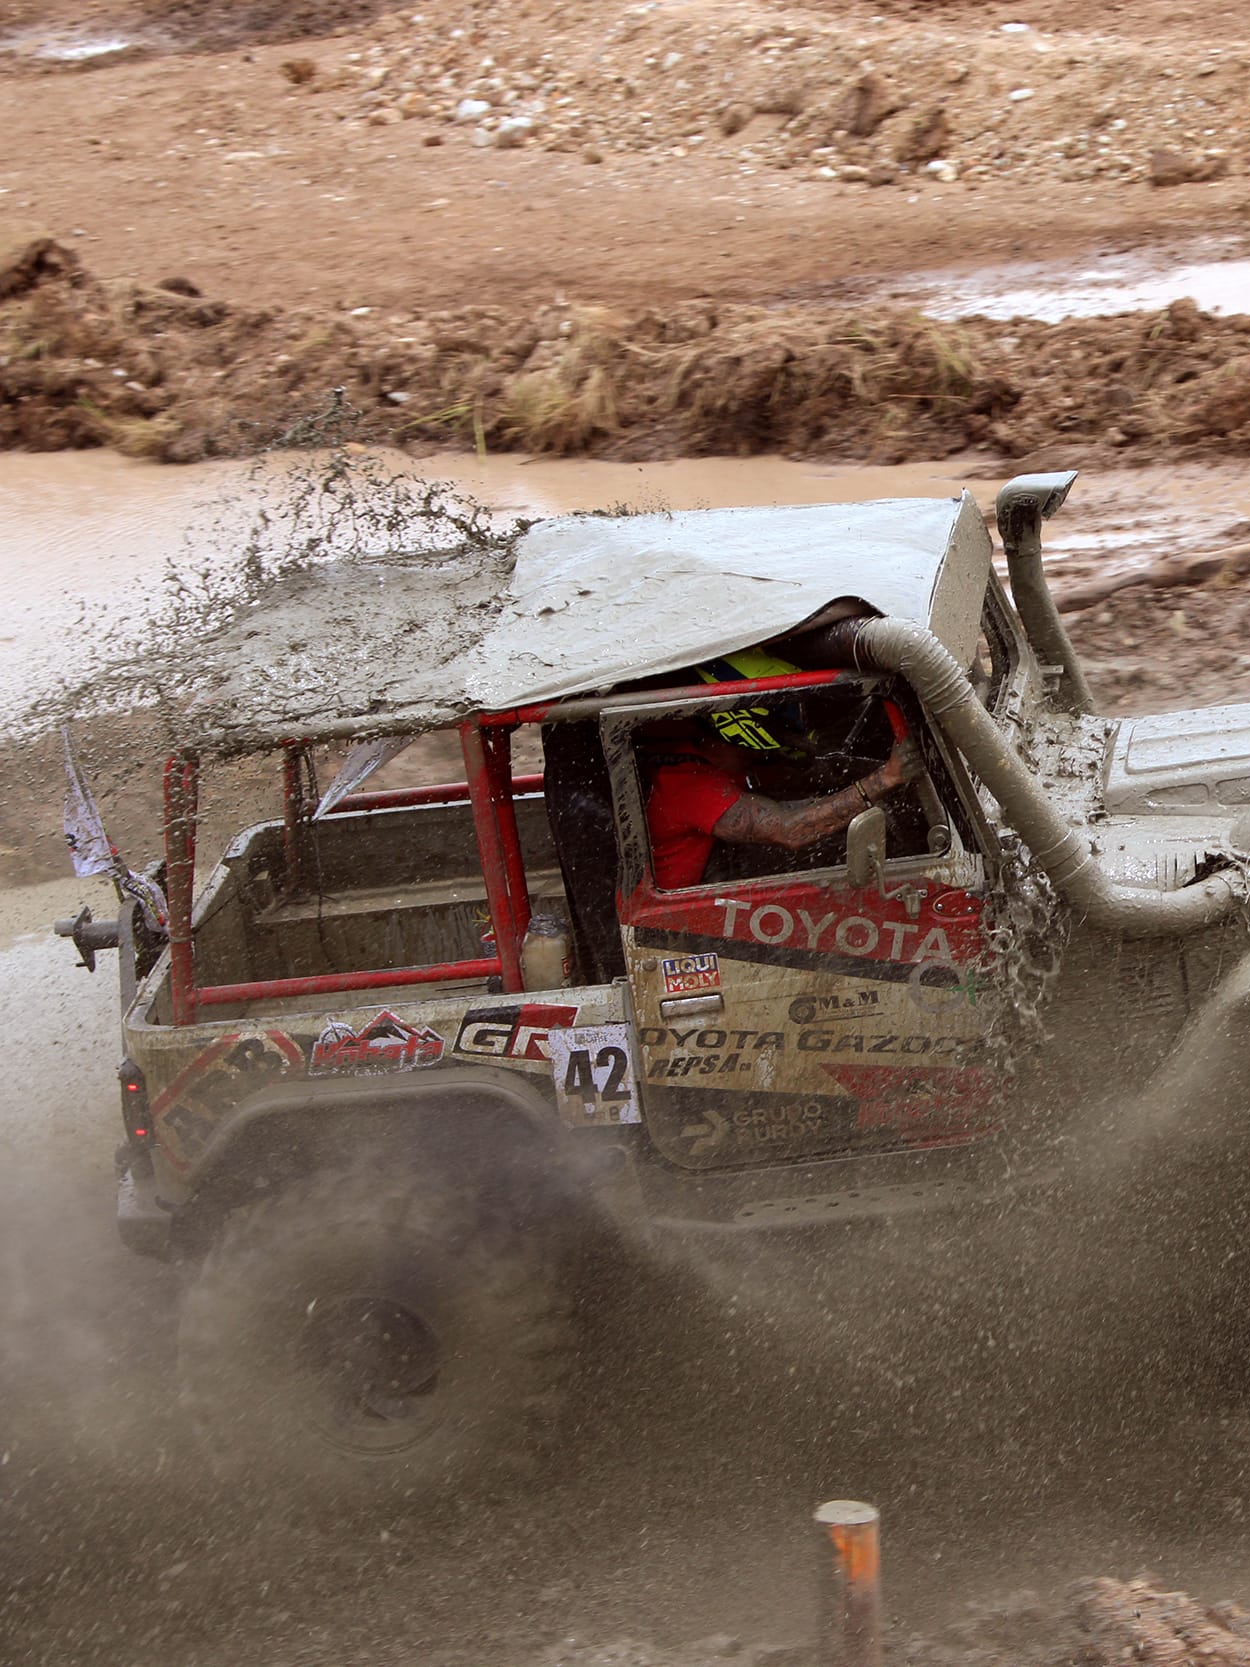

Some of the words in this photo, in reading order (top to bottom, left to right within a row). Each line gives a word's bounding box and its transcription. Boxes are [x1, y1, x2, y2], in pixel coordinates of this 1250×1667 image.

[714, 897, 953, 964] TOYOTA
[665, 956, 716, 976] LIQUI
[667, 971, 718, 992] MOLY
[640, 1027, 785, 1053] OYOTA
[564, 1046, 632, 1103] 42
